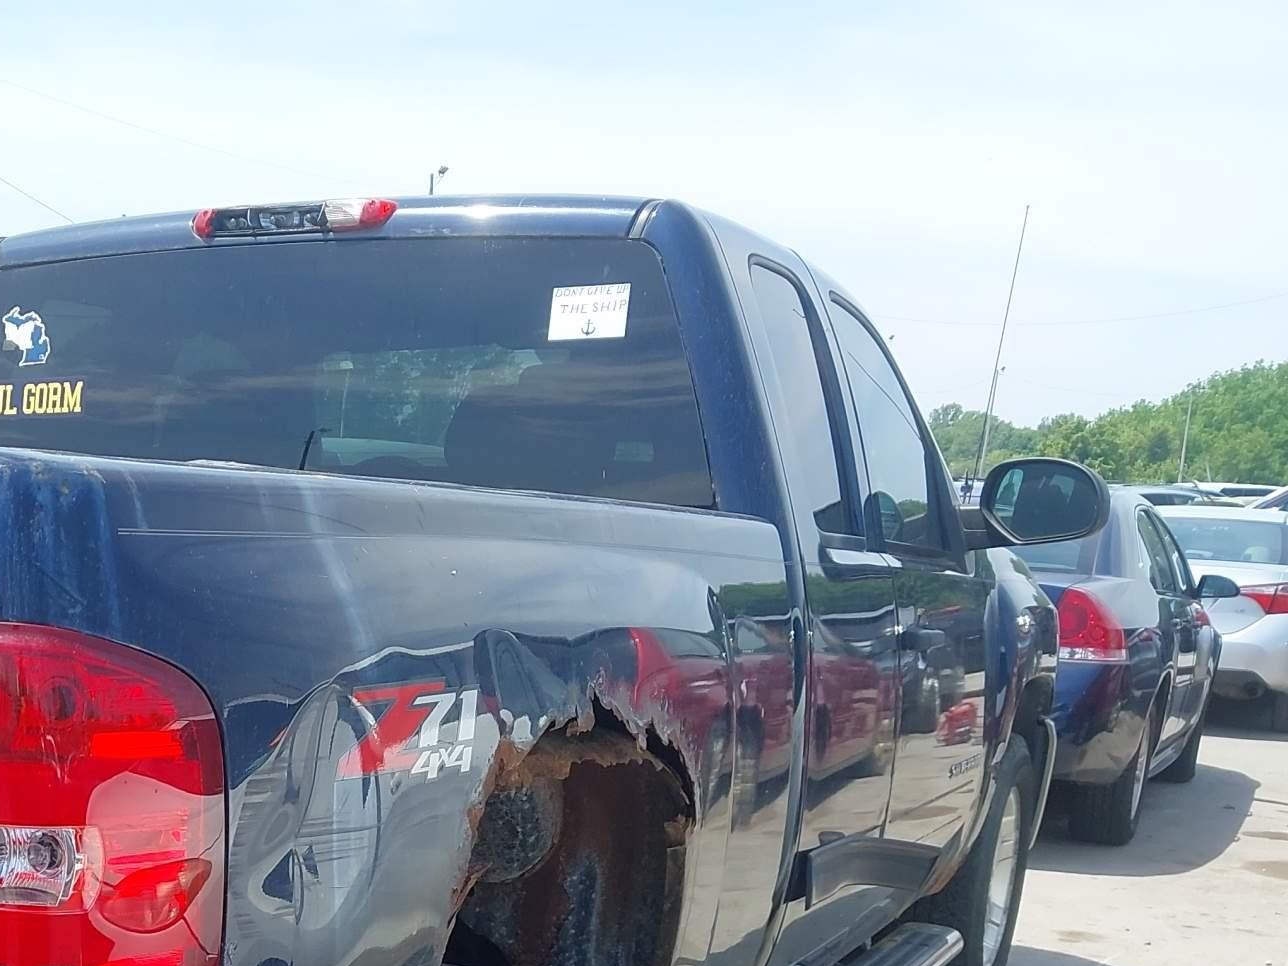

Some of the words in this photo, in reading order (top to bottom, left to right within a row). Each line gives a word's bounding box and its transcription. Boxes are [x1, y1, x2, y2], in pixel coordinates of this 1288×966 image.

[587, 285, 615, 296] GIVE
[559, 303, 590, 315] THE
[592, 299, 628, 313] SHIP
[335, 680, 479, 781] Z71
